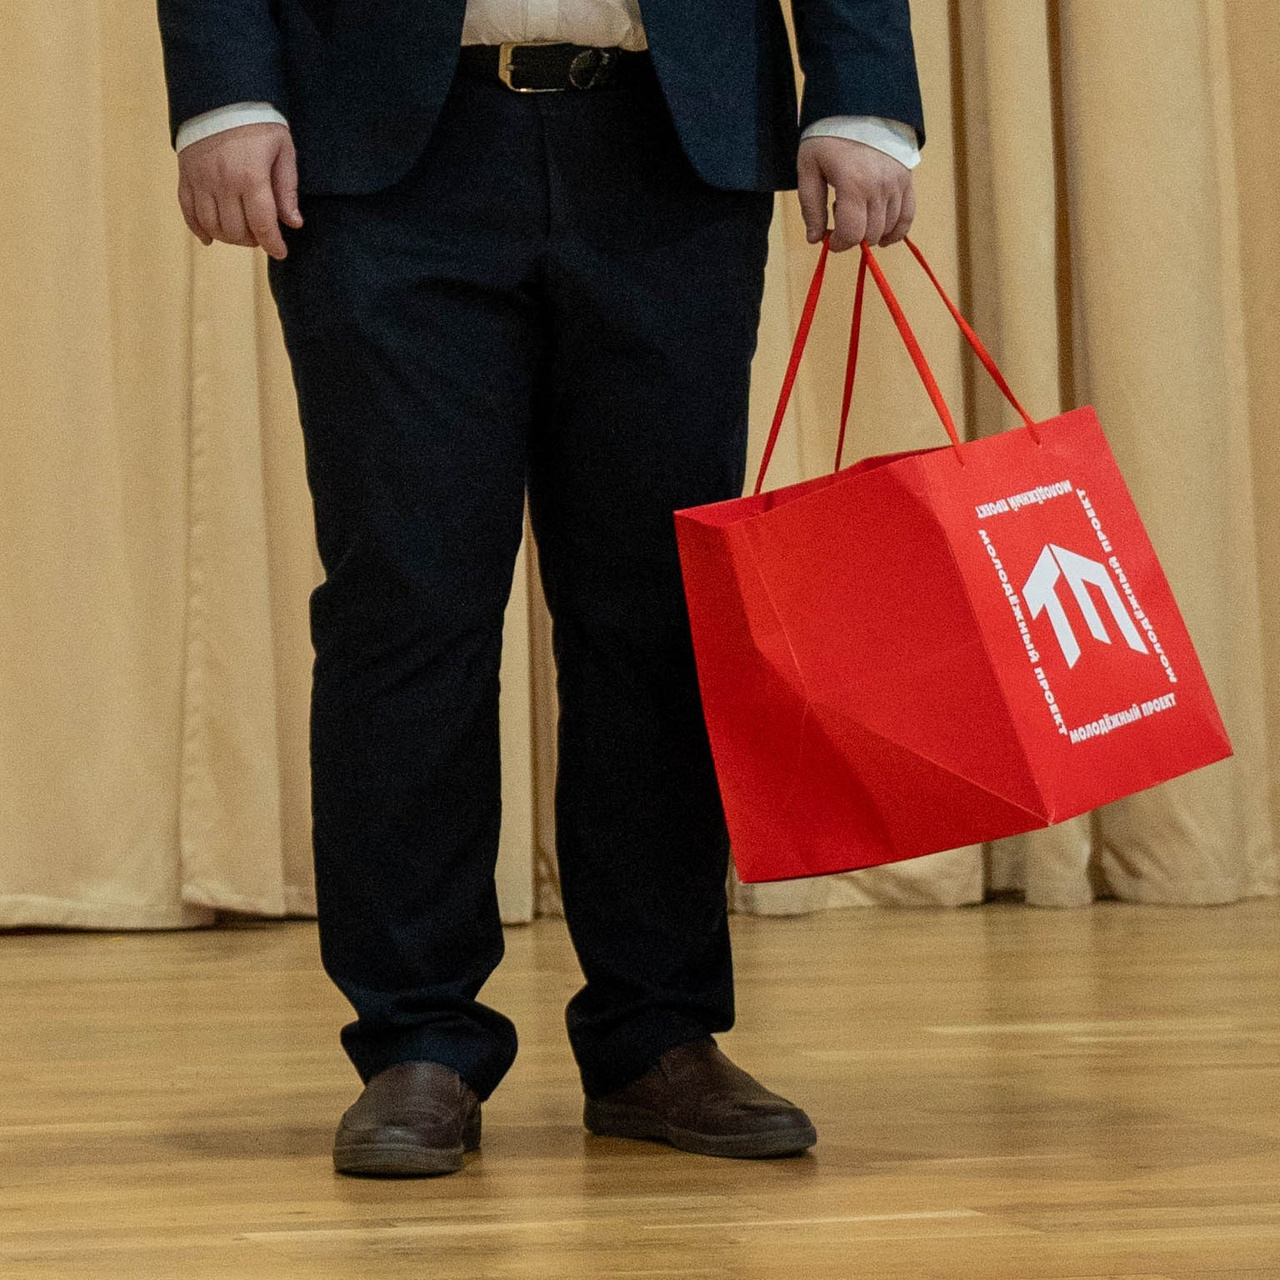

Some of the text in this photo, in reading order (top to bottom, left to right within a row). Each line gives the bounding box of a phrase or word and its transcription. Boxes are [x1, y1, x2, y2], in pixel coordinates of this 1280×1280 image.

[977, 529, 1068, 736] МОЛОДЁЖНЫЙ ПРОЕКТ
[1075, 488, 1178, 683] МОЛОДЁЖНЫЙ ПРОЕКТ
[1069, 692, 1177, 743] МОЛОДЁЖНЫЙ ПРОЕКТ
